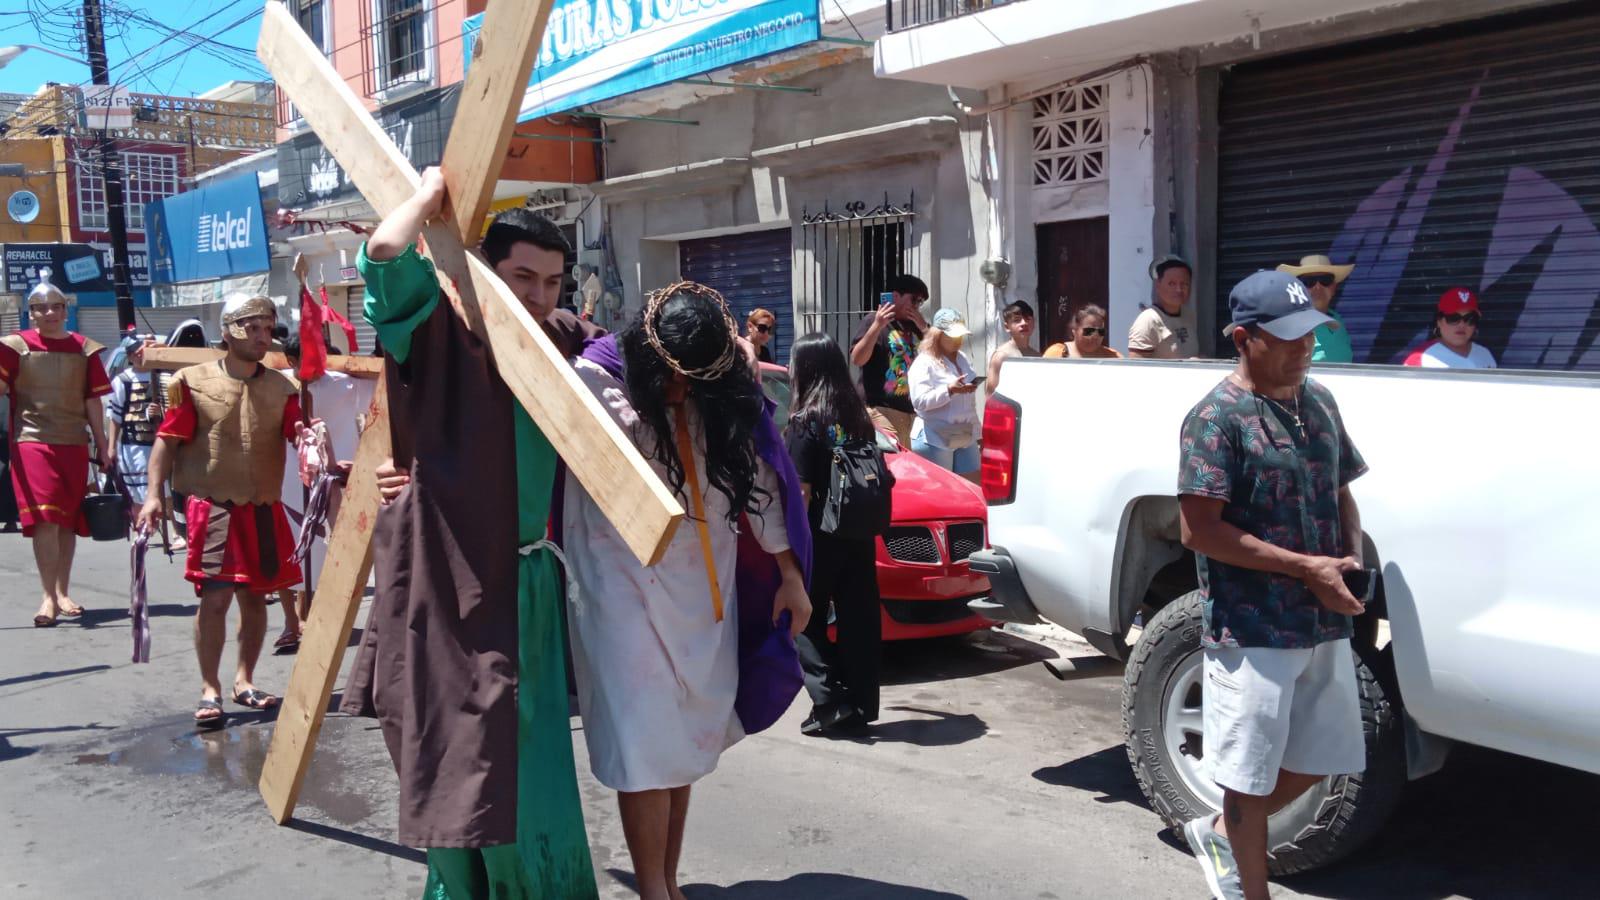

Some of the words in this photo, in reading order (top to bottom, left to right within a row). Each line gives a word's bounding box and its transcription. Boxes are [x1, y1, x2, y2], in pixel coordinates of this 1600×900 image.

[707, 27, 753, 52] NUESTRO
[211, 206, 251, 252] telcel
[6, 250, 52, 261] REPARACELL
